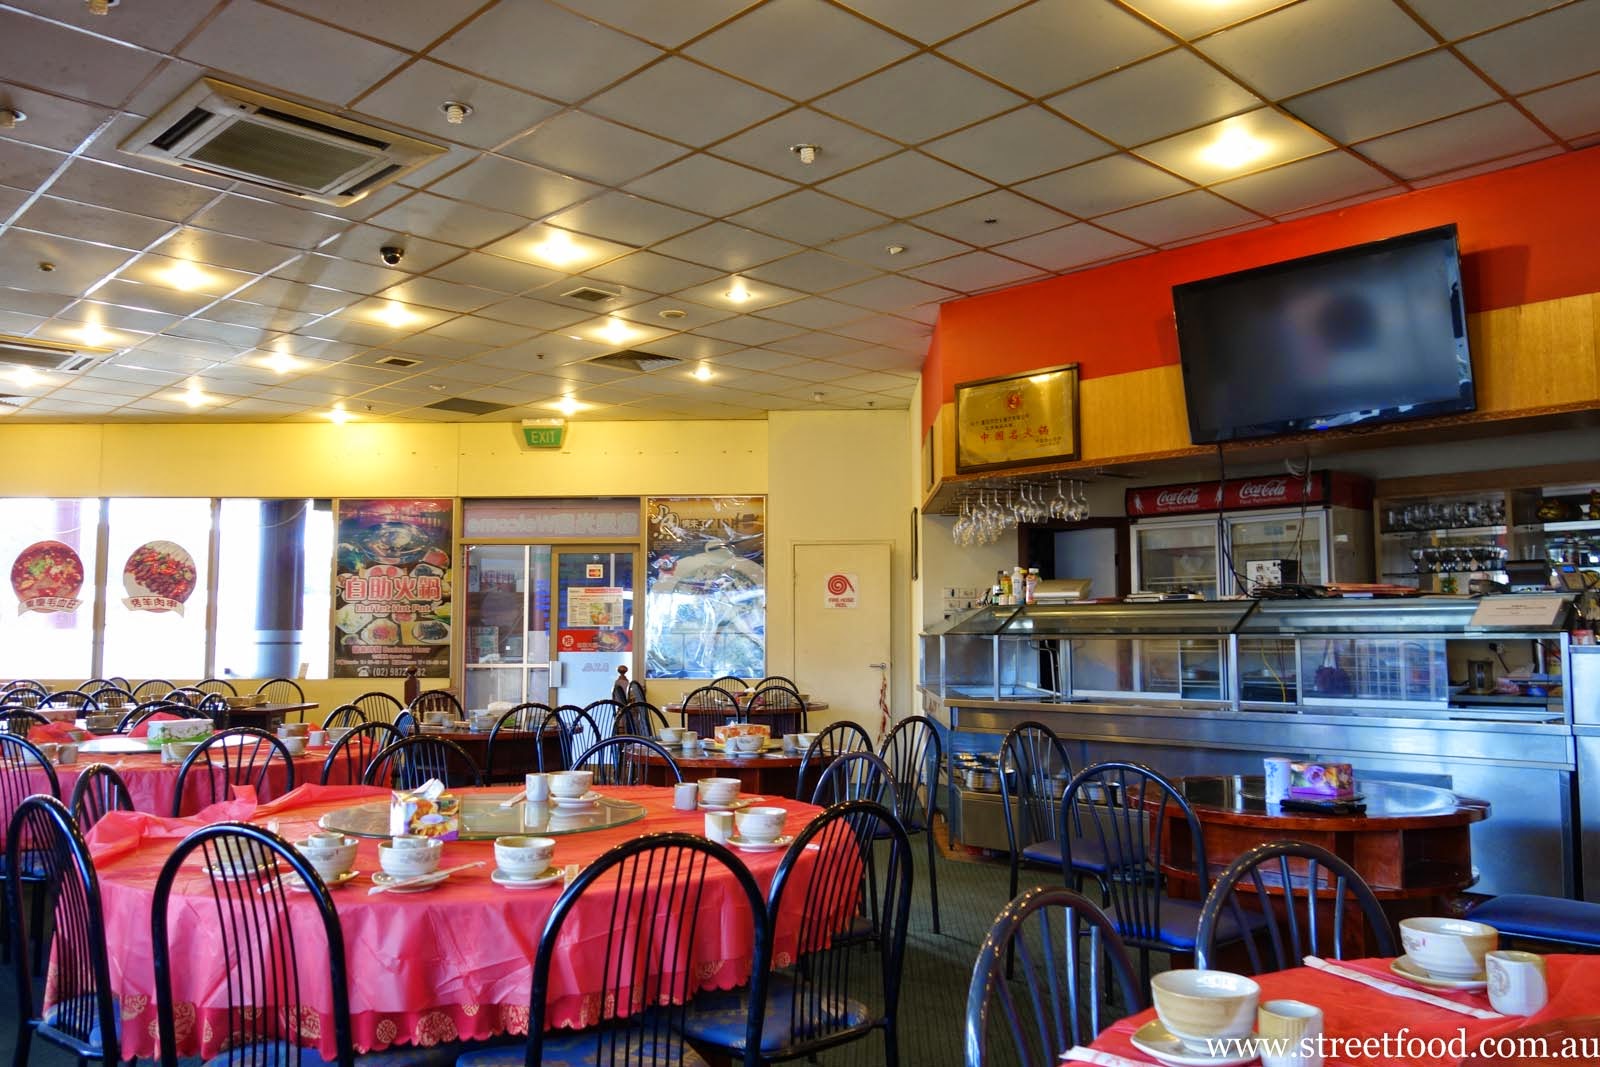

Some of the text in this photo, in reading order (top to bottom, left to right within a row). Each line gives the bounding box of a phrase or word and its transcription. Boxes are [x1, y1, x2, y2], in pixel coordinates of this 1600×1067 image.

[531, 431, 555, 444] EXIT
[345, 575, 442, 601] 自助火鍋
[372, 667, 388, 677] (02)
[389, 667, 408, 677] 9872
